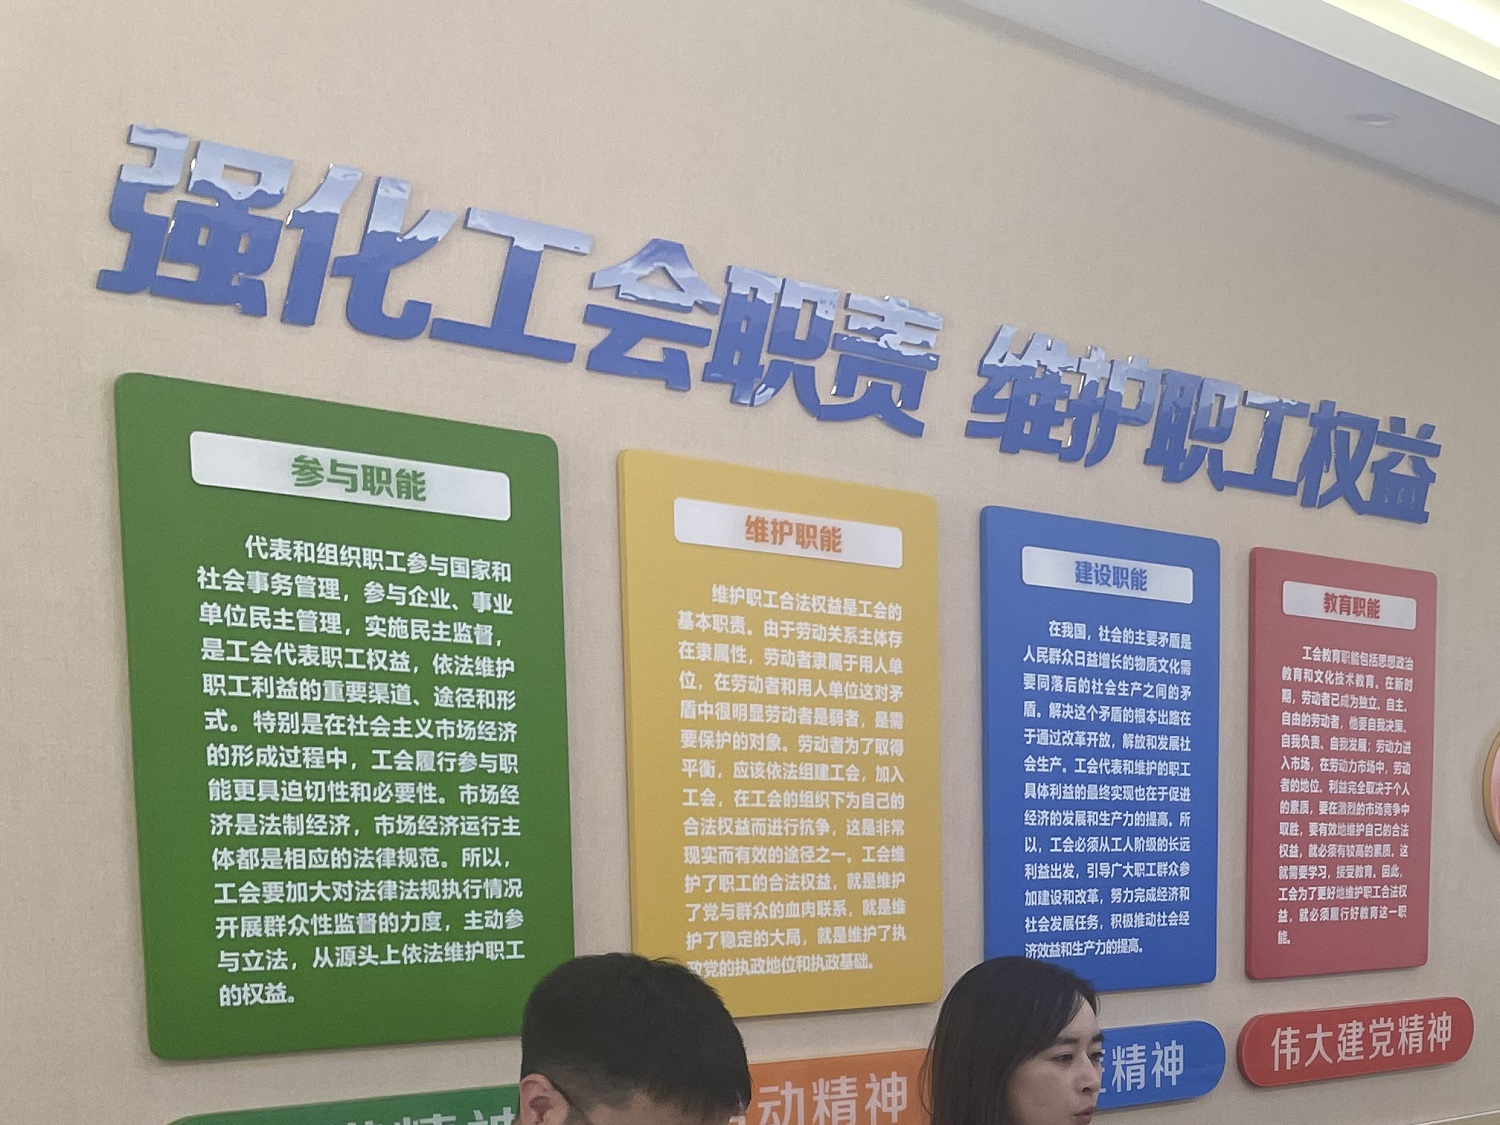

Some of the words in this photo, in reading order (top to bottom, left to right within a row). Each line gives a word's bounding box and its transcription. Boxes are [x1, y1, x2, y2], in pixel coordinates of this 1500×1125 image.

[96, 123, 945, 439] 强化工会职责
[964, 323, 1442, 524] 维护职工权益
[291, 455, 426, 501] 参与职能
[745, 515, 842, 553] 维护职能
[245, 535, 511, 582] 代表和组织职工参与国家和
[197, 566, 513, 615] 社会事务管理，参与企业、事业
[1075, 560, 1148, 592] 建设职能
[1323, 592, 1380, 619] 教育职能
[199, 602, 504, 646] 单位民主管理，实施民主监督，
[201, 637, 515, 678] 是工会代表职工权益，依法维护
[203, 673, 516, 711] 职工利益的重要渠道、途径和形
[204, 708, 517, 742] 式。特别是在社会主义市场经济
[206, 743, 518, 774] 的形成过程中，工会履行参与职
[208, 778, 520, 806] 能更具迫切性和必要性。市场经
[210, 813, 521, 837] 济是法制经济，市场经济运行主
[212, 847, 511, 871] 体都是相应的法律规范。所以，
[214, 878, 523, 905] 工会要加大对法律法规执行情况
[215, 909, 524, 939] 开展群众性监督的力度，主动参
[218, 940, 525, 973] 与立法，从源头上依法维护职工
[219, 982, 295, 1007] 的权益。
[1271, 1011, 1453, 1072] 伟大建党精神
[1099, 1040, 1184, 1093] 精神
